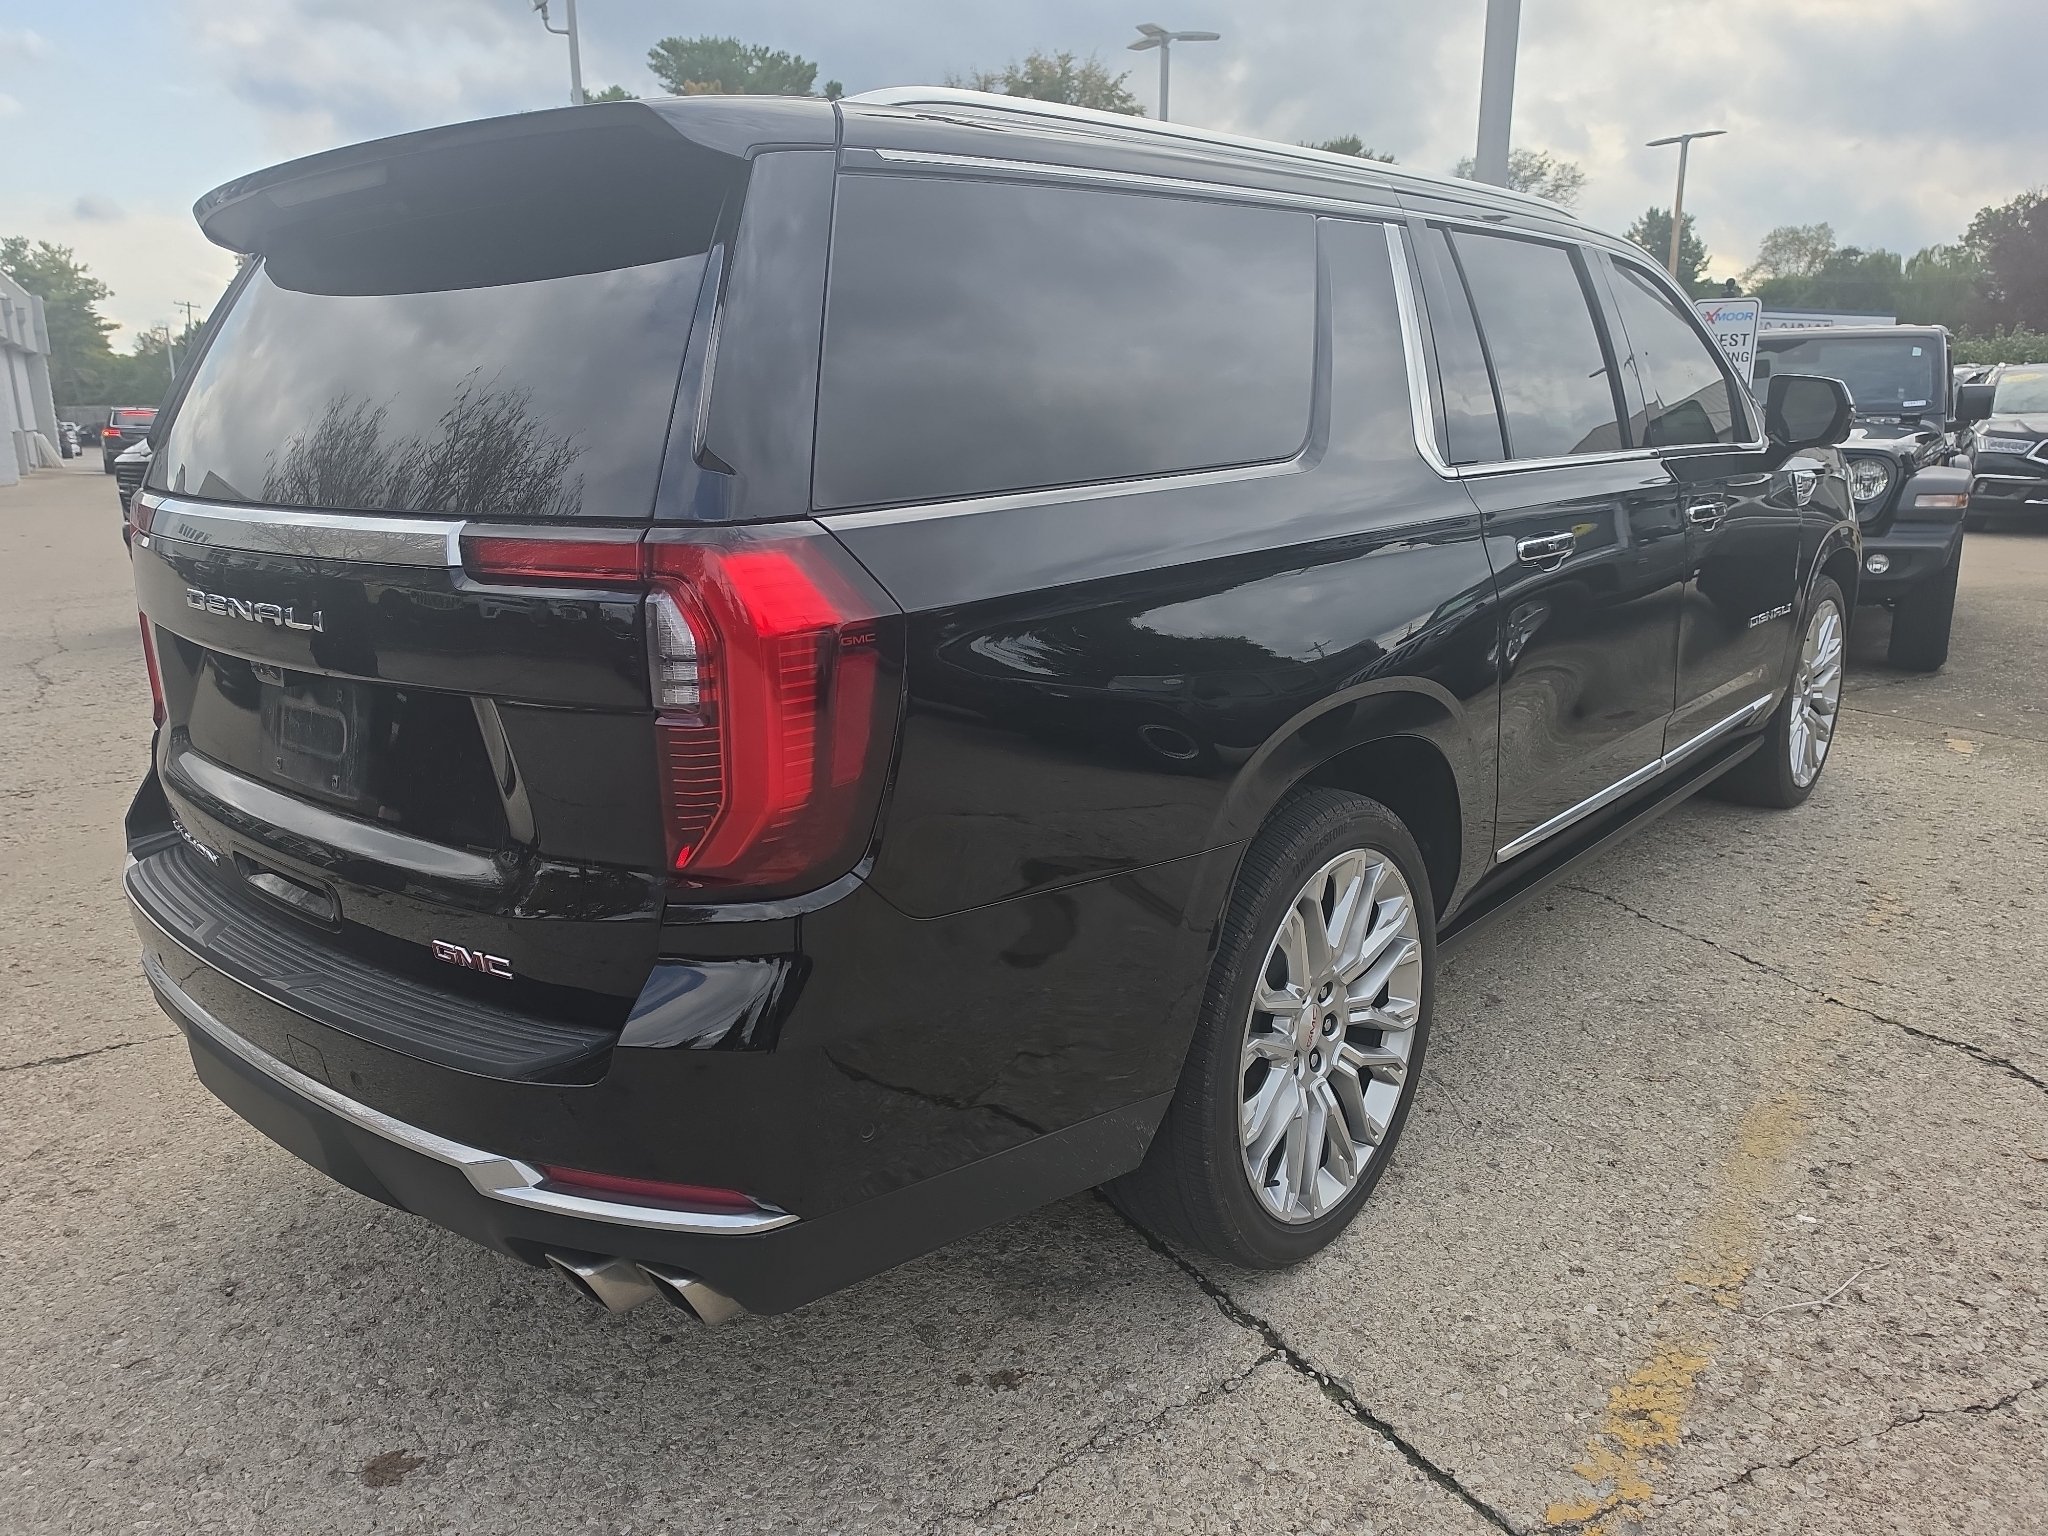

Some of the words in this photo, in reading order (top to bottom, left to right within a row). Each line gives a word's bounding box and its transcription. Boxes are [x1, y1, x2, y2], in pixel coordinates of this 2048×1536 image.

[1703, 307, 1754, 325] XMOOR
[1715, 333, 1750, 347] EST
[187, 587, 325, 633] DENALI
[1748, 602, 1792, 629] DENALI
[841, 633, 877, 646] GMC
[432, 939, 514, 980] GMC
[1306, 1007, 1318, 1048] GMC
